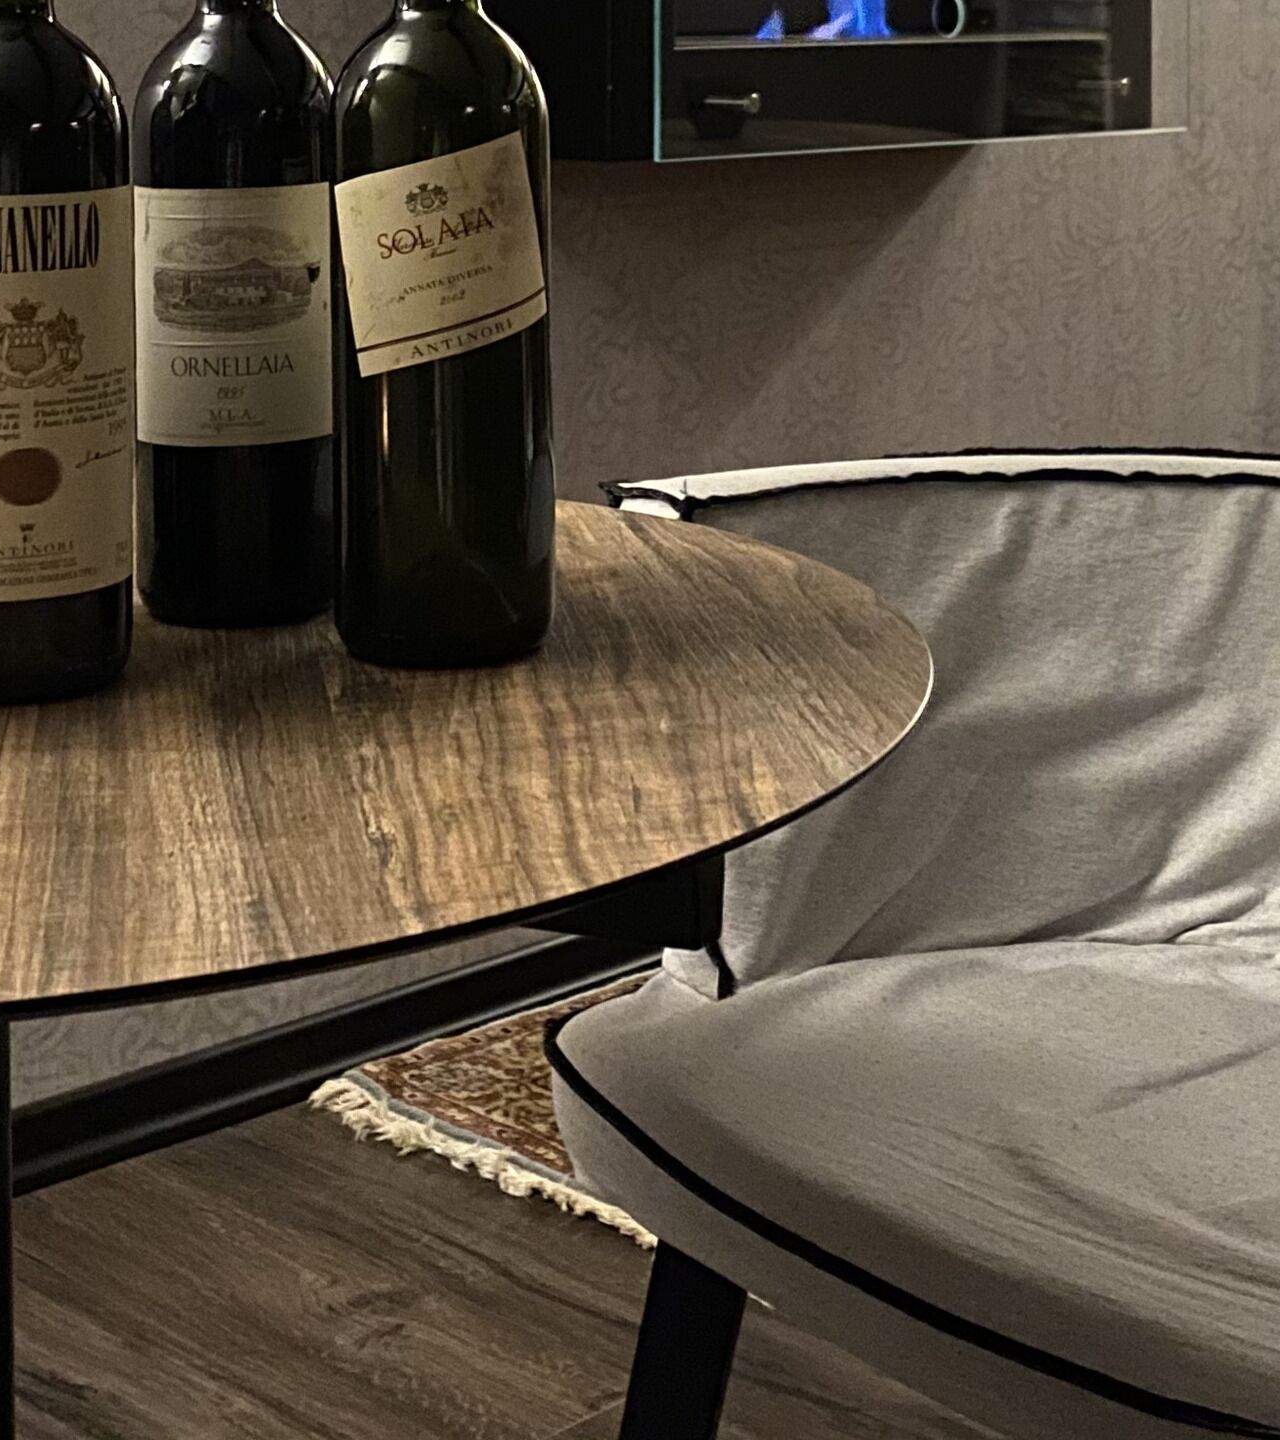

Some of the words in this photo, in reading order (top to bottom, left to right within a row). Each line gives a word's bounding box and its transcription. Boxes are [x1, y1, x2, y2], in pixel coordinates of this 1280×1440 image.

[377, 206, 496, 260] SOLAIA
[409, 317, 515, 359] ANTINORI
[171, 352, 295, 378] ORNELLAIA
